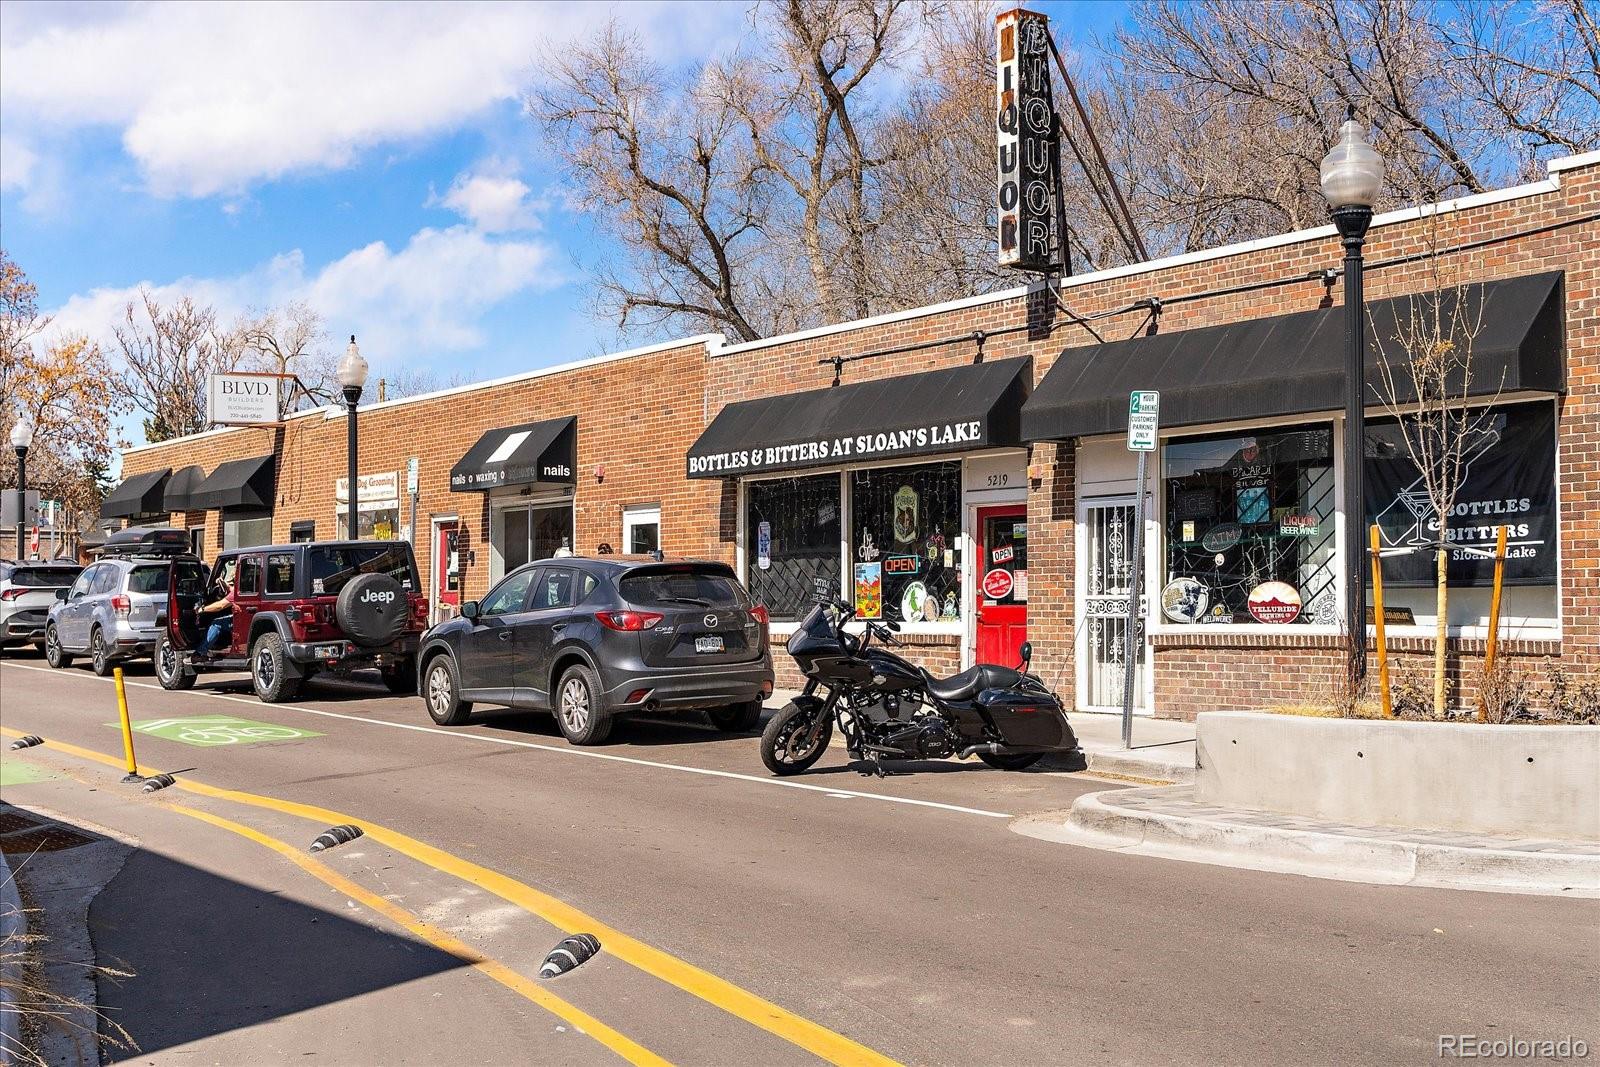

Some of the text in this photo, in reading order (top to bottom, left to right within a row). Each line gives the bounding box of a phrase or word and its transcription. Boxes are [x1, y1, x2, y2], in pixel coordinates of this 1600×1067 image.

[1024, 21, 1051, 256] LIQUOR
[221, 380, 272, 396] BLVD.
[1132, 395, 1139, 411] 2
[689, 421, 982, 473] BOTTLES & BITTERS AT SLOAN'S LAKE
[451, 473, 466, 485] nails
[475, 470, 498, 483] waxing
[543, 464, 571, 477] nails
[987, 474, 1008, 487] 5219
[1446, 498, 1531, 517] BOTTLES
[1283, 515, 1317, 526] LIQUOR
[1280, 526, 1318, 535] BEER WINE
[1210, 529, 1236, 548] ATM
[994, 548, 1012, 561] OPEN
[1504, 546, 1537, 559] Lake
[884, 557, 916, 572] OPEN
[360, 589, 395, 604] Jeep
[1252, 605, 1298, 613] TELLURIDE
[1259, 611, 1285, 619] BREWING
